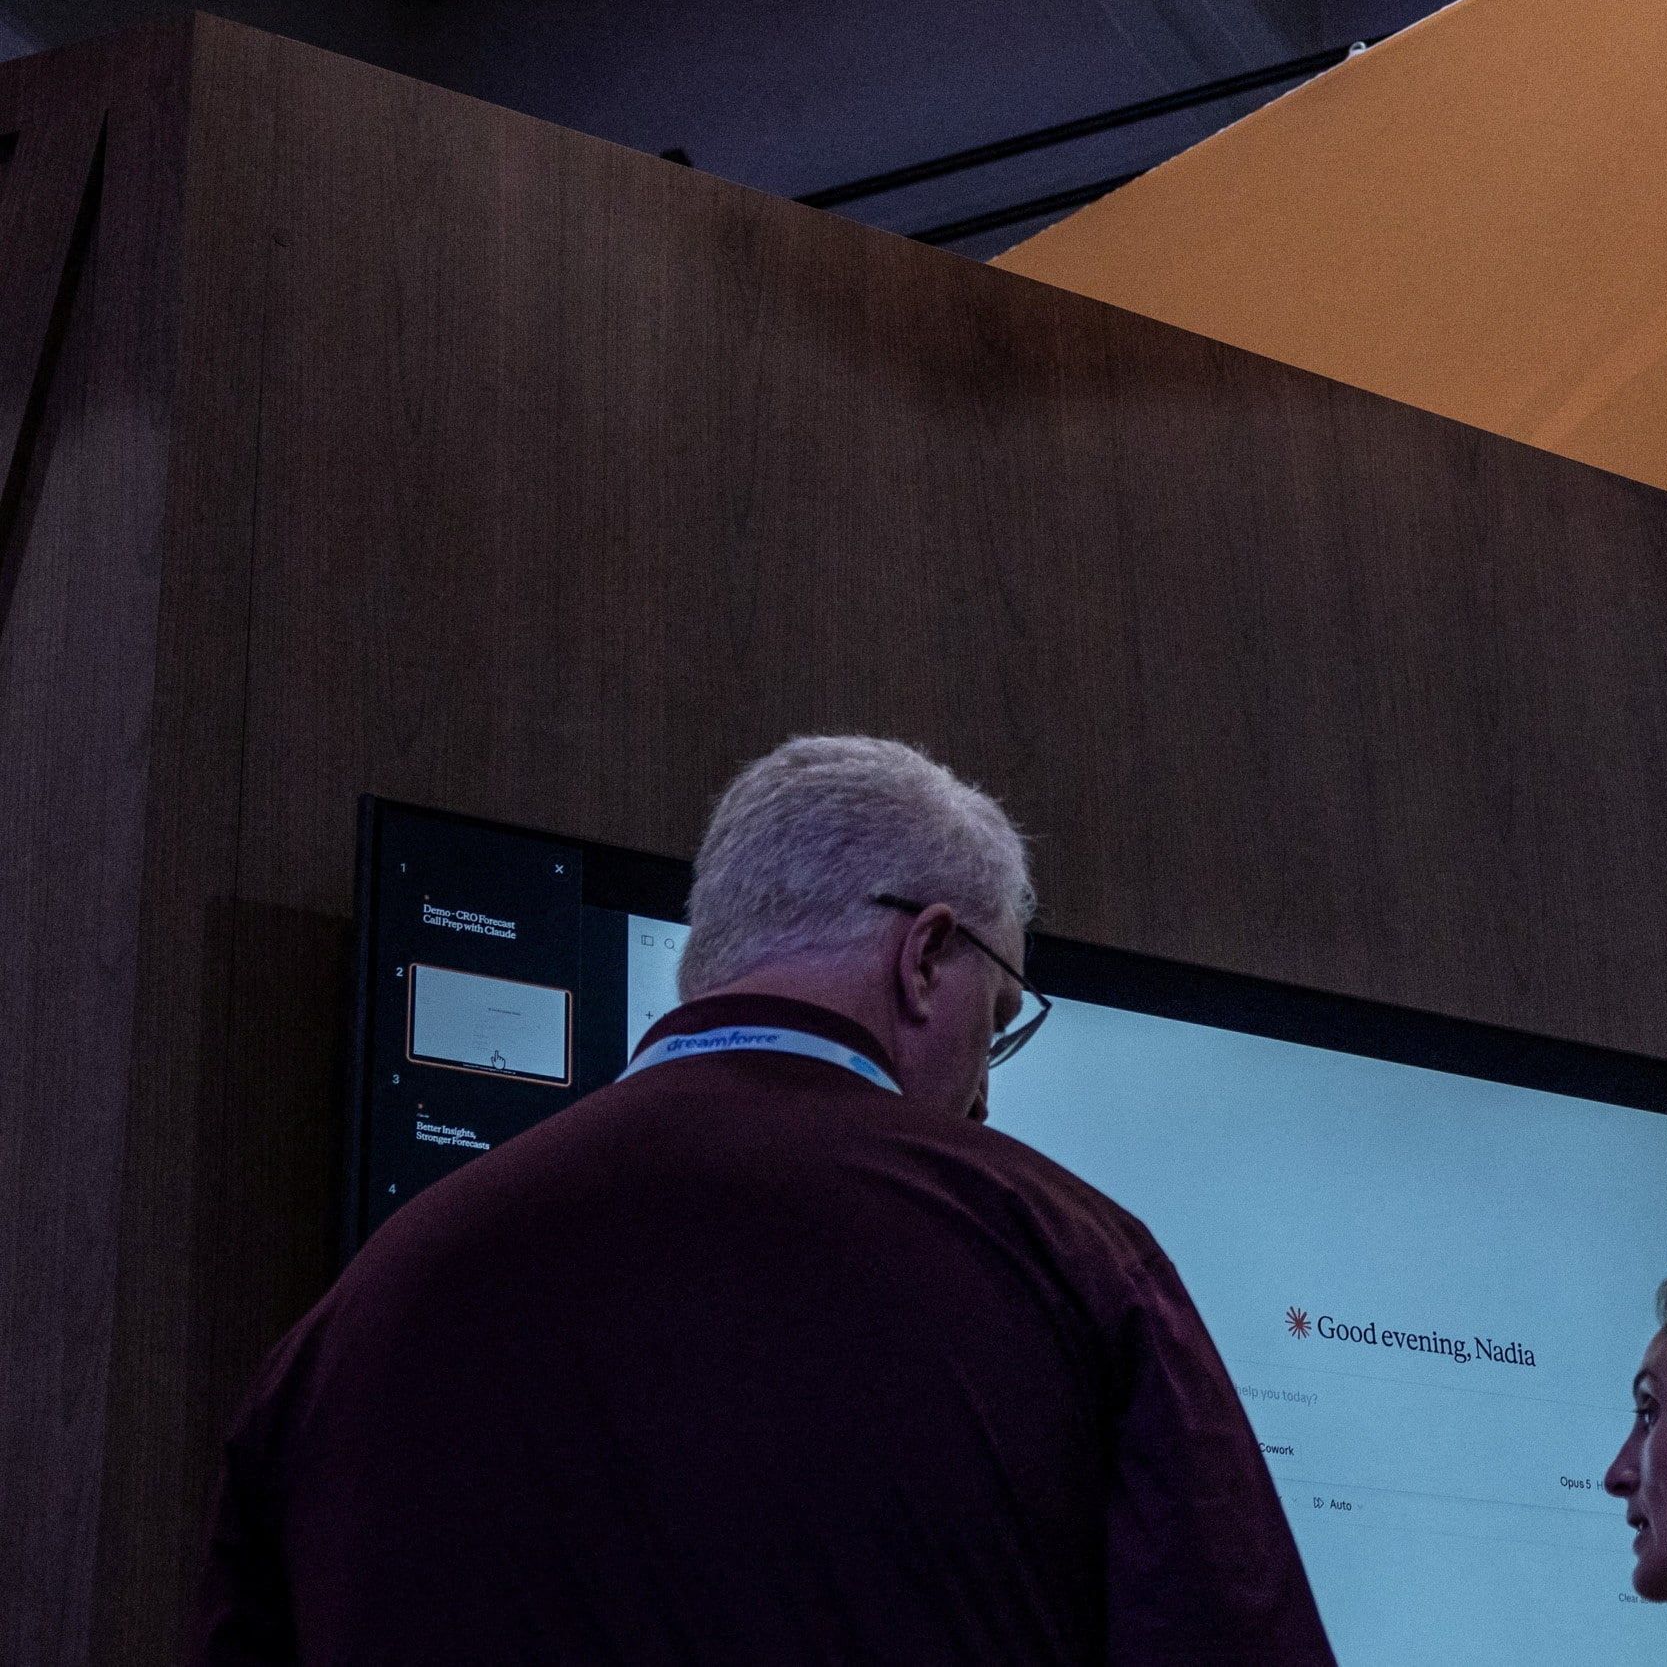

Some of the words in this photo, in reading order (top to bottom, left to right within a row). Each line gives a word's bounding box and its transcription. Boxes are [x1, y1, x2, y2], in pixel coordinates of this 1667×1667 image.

[400, 863, 406, 873] 1
[423, 904, 451, 917] Demo
[455, 910, 478, 922] CRO
[478, 914, 516, 930] Forecast
[422, 914, 441, 926] Call
[442, 917, 463, 932] Prep
[463, 922, 484, 934] with
[484, 925, 517, 940] Claude
[396, 966, 404, 977] 2
[667, 1031, 778, 1052] dreamforce
[392, 1074, 400, 1085] 3
[416, 1121, 441, 1134] Better
[442, 1125, 477, 1140] Insights,
[416, 1131, 451, 1146] Stronger
[451, 1136, 490, 1150] Forecasts
[388, 1183, 397, 1195] 4
[1317, 1315, 1378, 1345] Good
[1381, 1329, 1472, 1364] evening,
[1474, 1337, 1537, 1367] Nadia
[1260, 1389, 1280, 1401] you
[1282, 1390, 1318, 1407] today?
[1258, 1443, 1295, 1456] Cowork
[1560, 1476, 1585, 1490] Opus
[1585, 1479, 1592, 1490] 5
[1329, 1499, 1352, 1511] Auto
[1618, 1592, 1639, 1604] Clear
